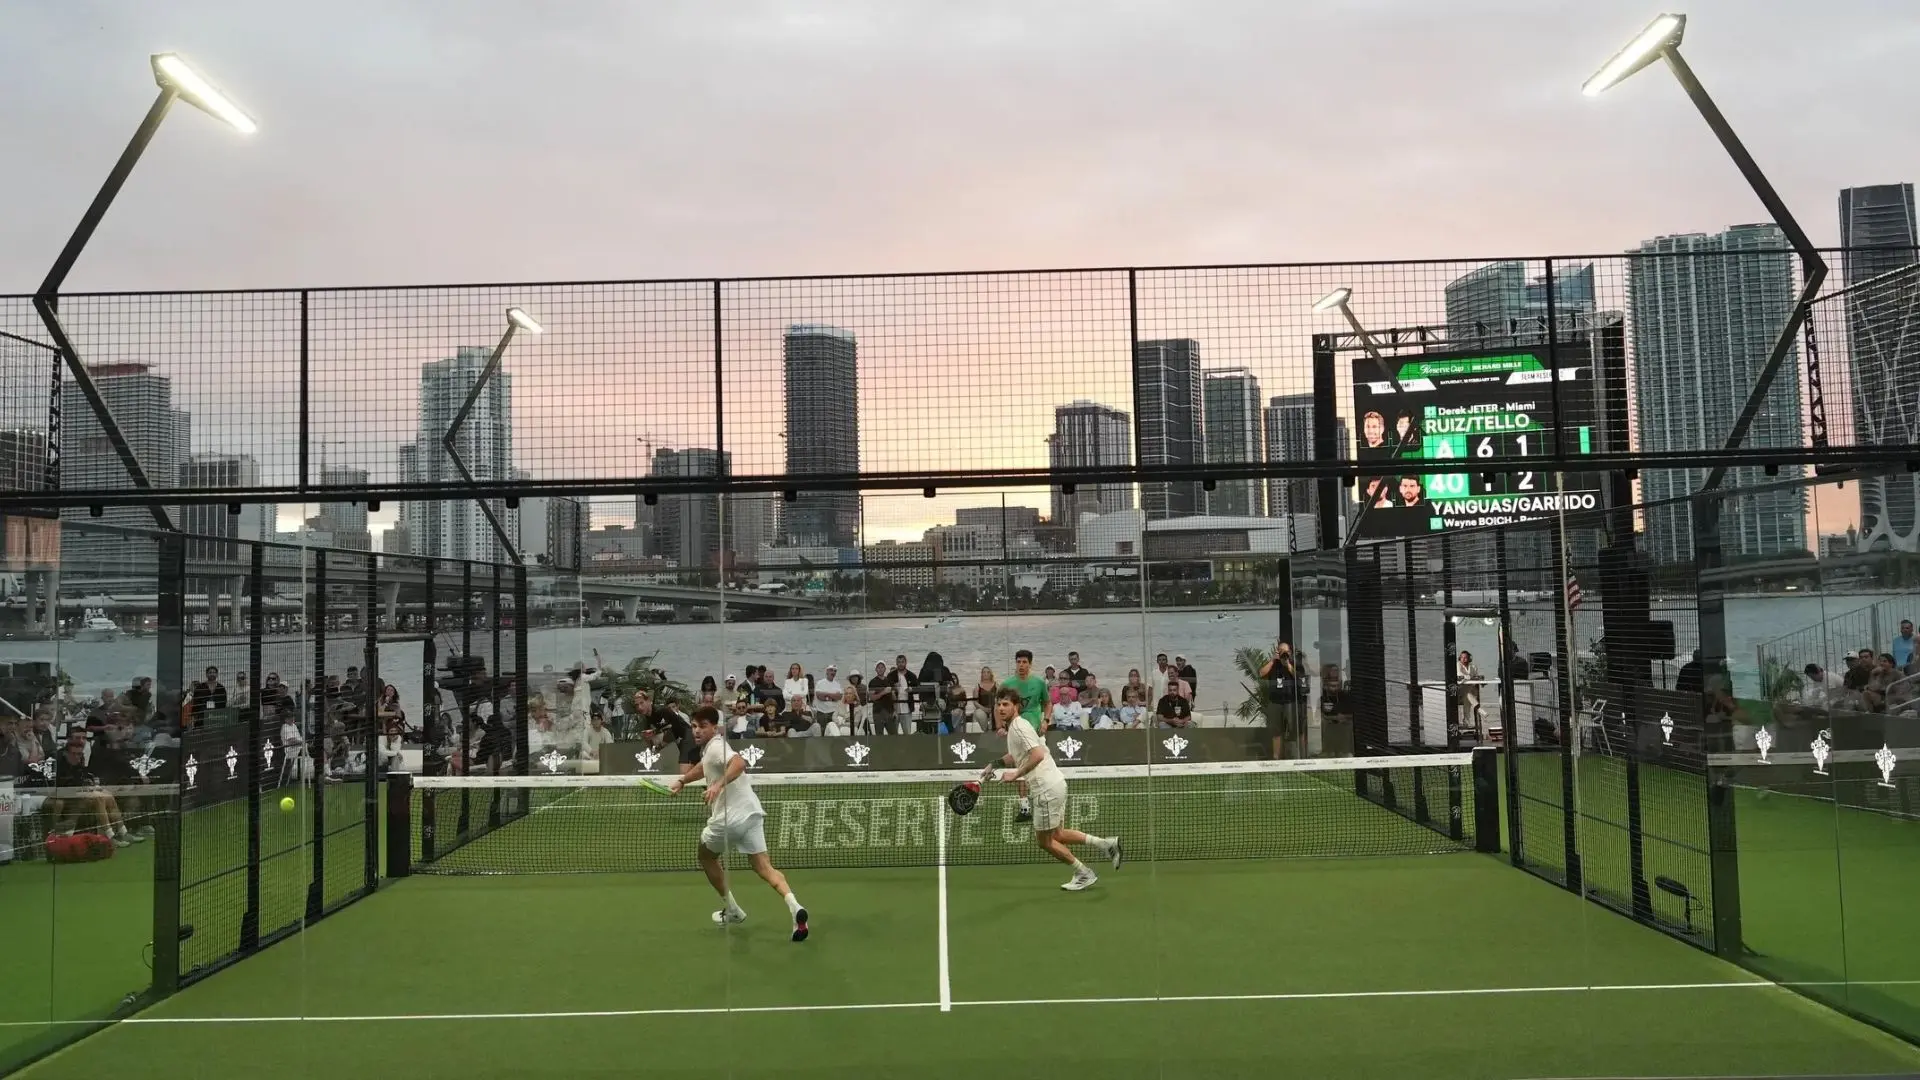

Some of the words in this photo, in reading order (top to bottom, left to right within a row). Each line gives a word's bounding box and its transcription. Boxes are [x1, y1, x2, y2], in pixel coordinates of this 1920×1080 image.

[1450, 365, 1464, 374] Cup
[1438, 406, 1466, 416] Derek
[1467, 404, 1498, 414] JETER
[1505, 401, 1536, 412] Miami
[1425, 413, 1530, 434] RUIZ/TELLO
[1435, 438, 1455, 459] A
[1476, 437, 1494, 459] 6
[1516, 435, 1528, 457] 1
[1429, 473, 1464, 494] 40
[1517, 471, 1534, 490] 2
[1431, 494, 1596, 515] YANGUAS/GARRIDO
[1443, 518, 1478, 529] Wayne
[1478, 515, 1513, 526] BOICH
[778, 797, 985, 851] RESERVE
[1001, 794, 1099, 844] CP
